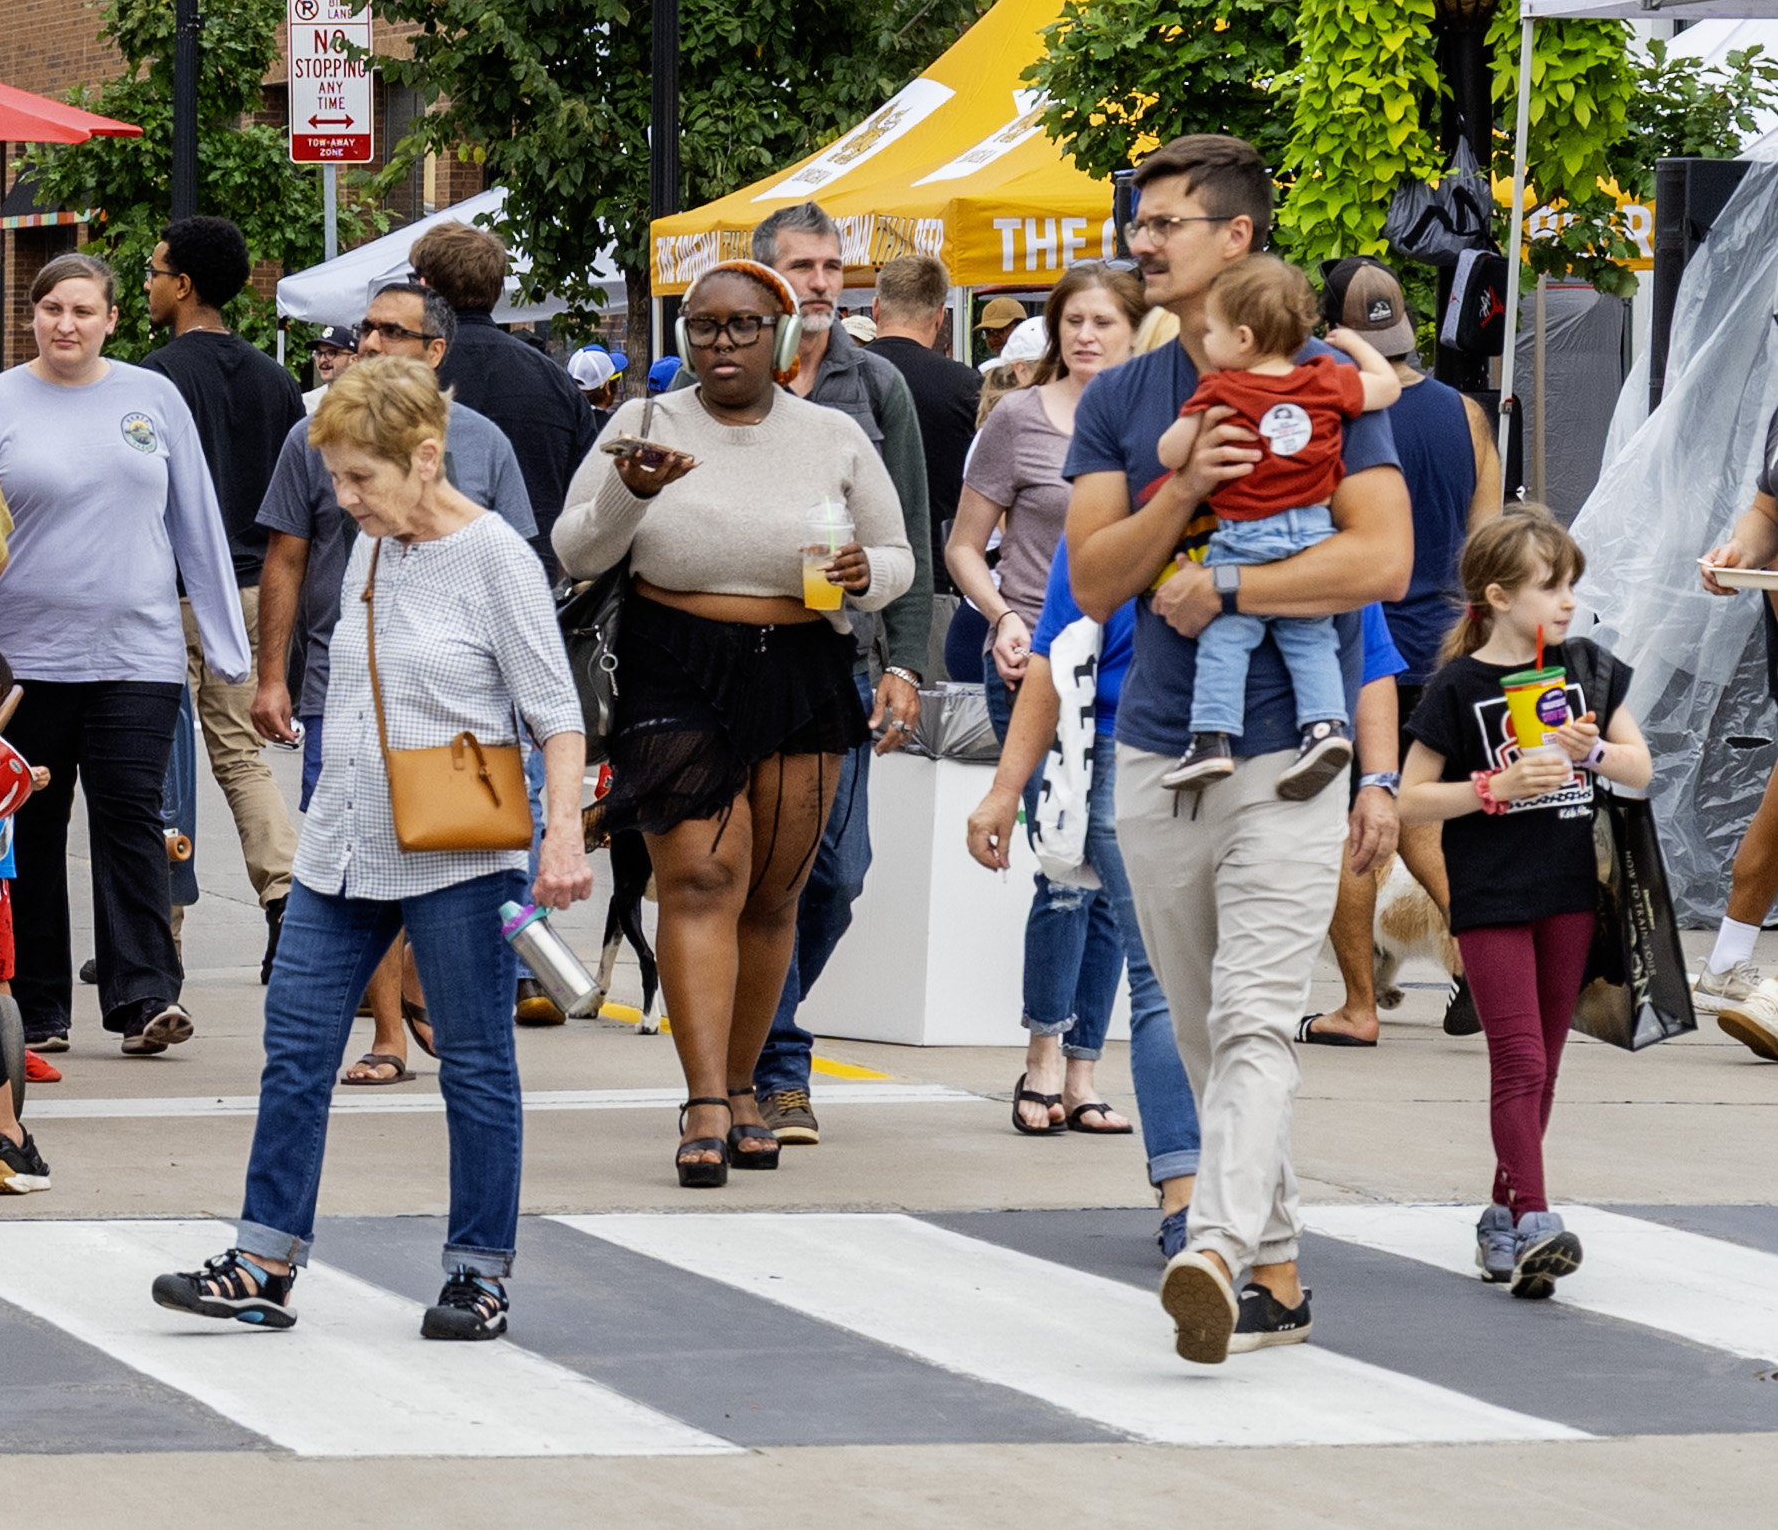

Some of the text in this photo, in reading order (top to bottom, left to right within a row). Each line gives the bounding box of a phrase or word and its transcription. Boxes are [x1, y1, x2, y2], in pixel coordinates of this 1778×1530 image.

[314, 29, 347, 54] NO
[295, 58, 367, 79] STOPPING
[318, 81, 344, 95] ANY
[317, 97, 346, 110] TIME
[319, 148, 344, 157] ZONE
[993, 216, 1088, 272] THE
[1624, 850, 1637, 879] HOW
[1630, 883, 1642, 900] TO
[1633, 902, 1649, 939] TRAIN
[1641, 942, 1658, 977] YOUR
